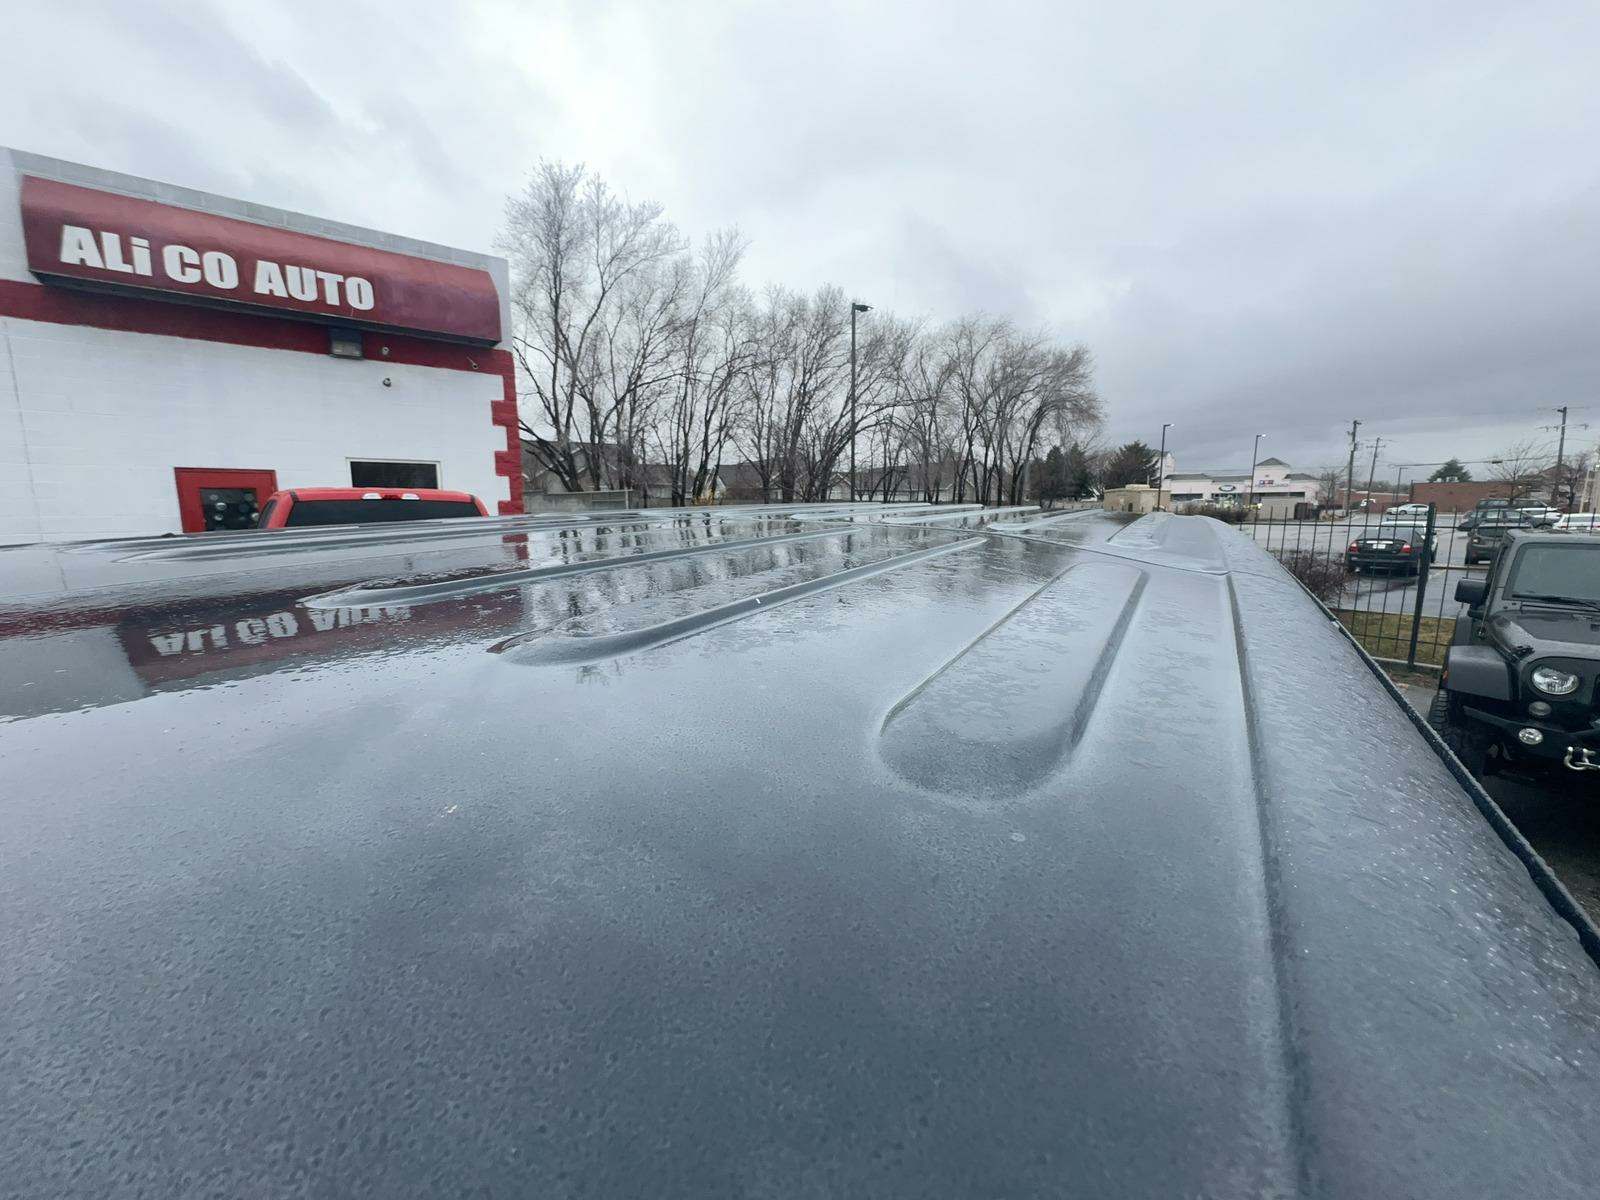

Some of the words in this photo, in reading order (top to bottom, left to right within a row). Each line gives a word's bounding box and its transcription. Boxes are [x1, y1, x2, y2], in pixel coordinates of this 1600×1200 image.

[60, 225, 153, 276] ALi
[162, 244, 239, 290] CO
[254, 260, 375, 311] AUTO
